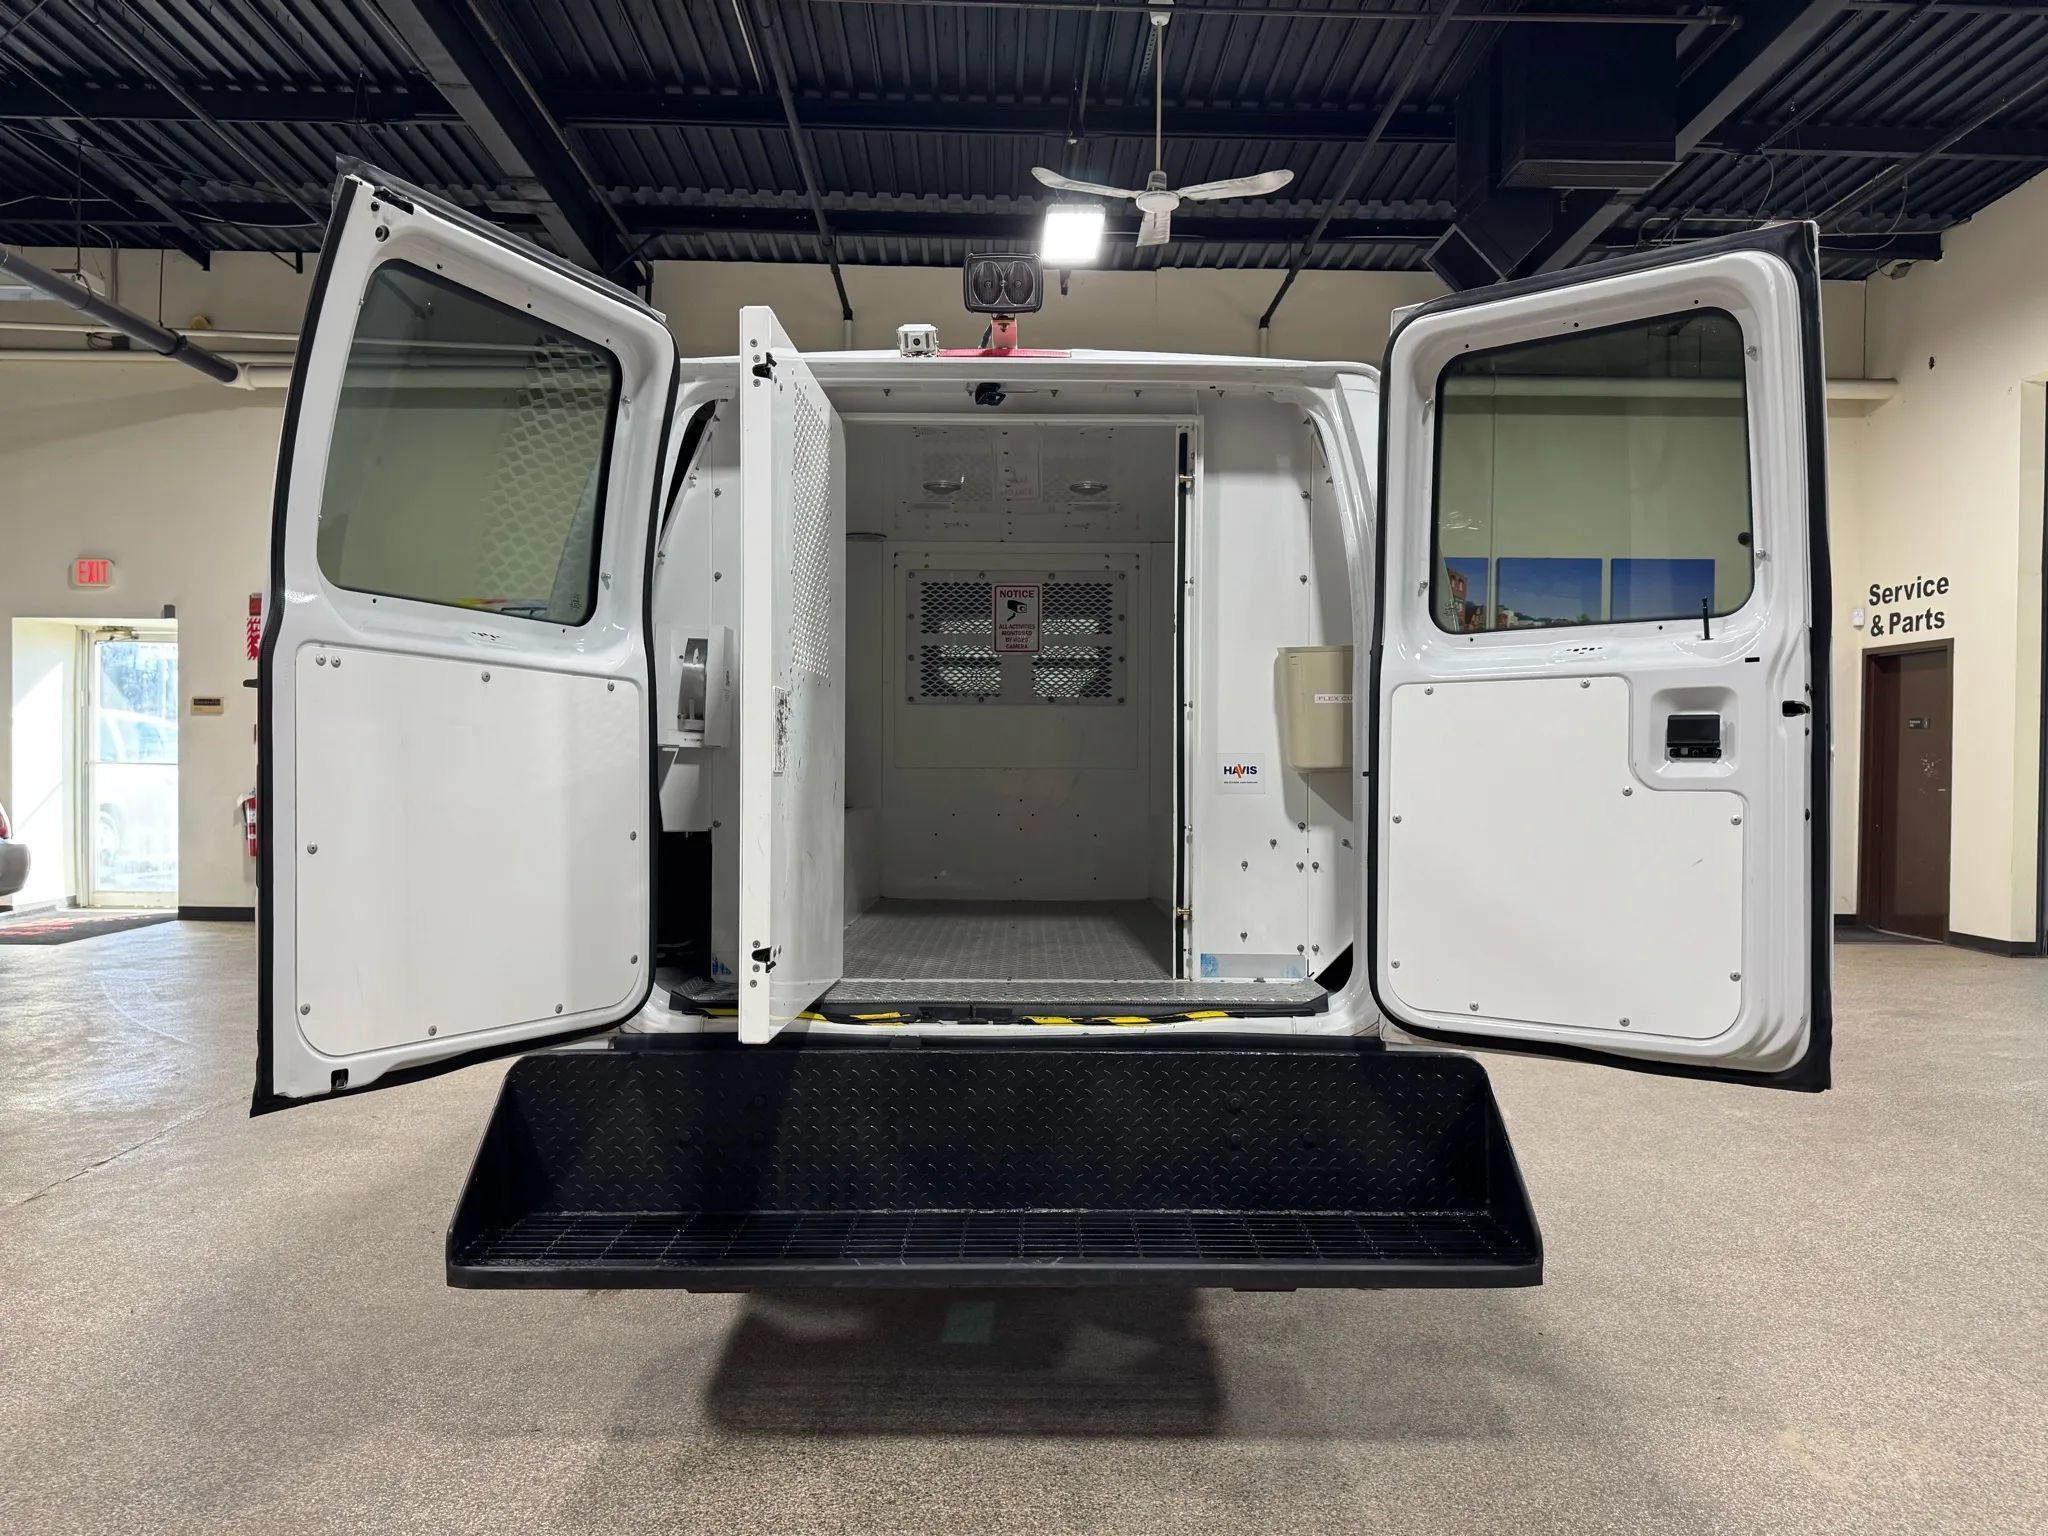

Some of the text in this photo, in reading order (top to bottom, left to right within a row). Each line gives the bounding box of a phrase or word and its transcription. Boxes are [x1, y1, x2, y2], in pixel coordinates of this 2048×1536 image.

[77, 560, 108, 584] EXIT
[1000, 590, 1034, 598] NOTICE
[1869, 576, 1950, 606] Service
[1870, 607, 1946, 637] & Parts
[1224, 765, 1258, 776] HAVIS
